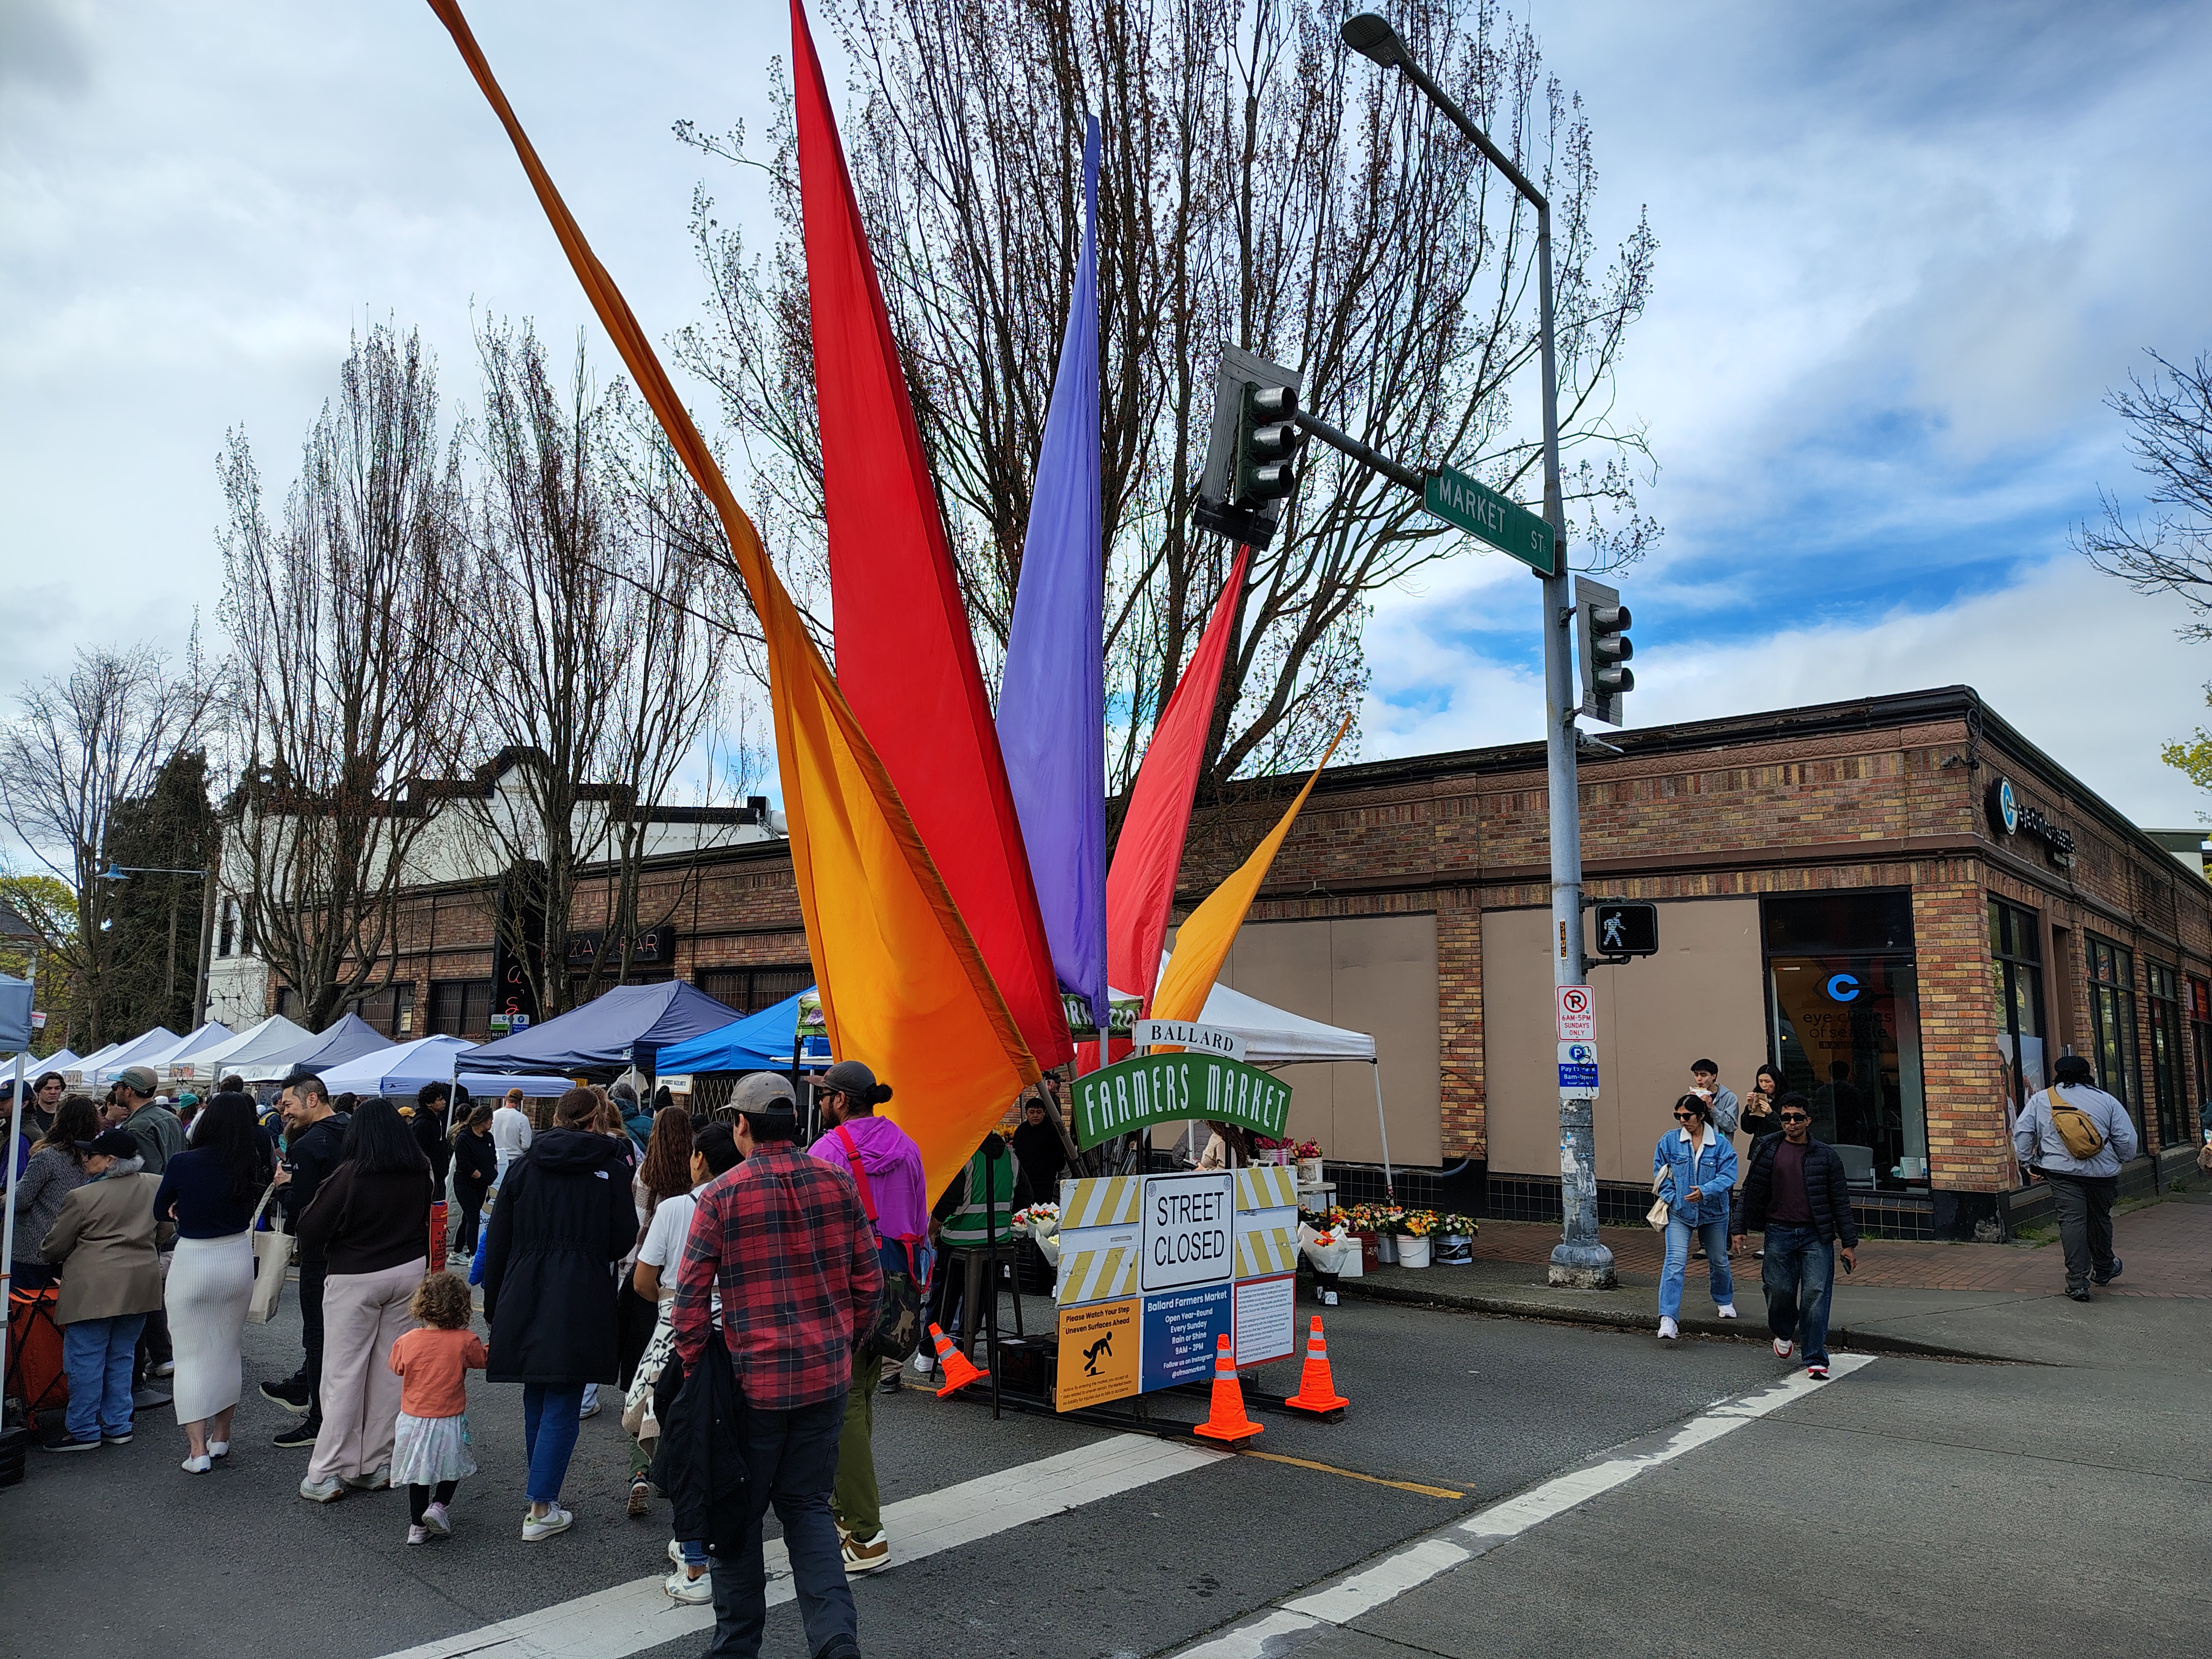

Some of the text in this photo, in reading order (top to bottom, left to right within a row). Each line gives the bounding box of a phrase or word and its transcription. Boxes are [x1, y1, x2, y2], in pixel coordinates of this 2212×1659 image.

[1439, 476, 1544, 553] MARKET ST
[1803, 1013, 1832, 1026] eye
[1151, 1025, 1233, 1051] BALLARD
[1810, 1024, 1887, 1038] of seale
[1085, 1063, 1285, 1136] FARMERS MARKET
[1157, 1192, 1224, 1226] STREET
[1155, 1230, 1224, 1266] CLOSED
[1148, 1290, 1227, 1312] Ballard Farmers Market
[1066, 1306, 1130, 1323] Please Watch Your Step
[1165, 1307, 1213, 1325] Open Year-Round
[1065, 1317, 1129, 1335] Uneven Surfaces Ahead
[1171, 1320, 1207, 1333] Every Sunday
[1172, 1335, 1184, 1344] Rain
[1192, 1331, 1206, 1340] Shine
[1176, 1346, 1188, 1354] 9AM
[1192, 1343, 1204, 1351] 2PM
[1164, 1360, 1178, 1369] Follow
[1191, 1354, 1213, 1363] Instagram
